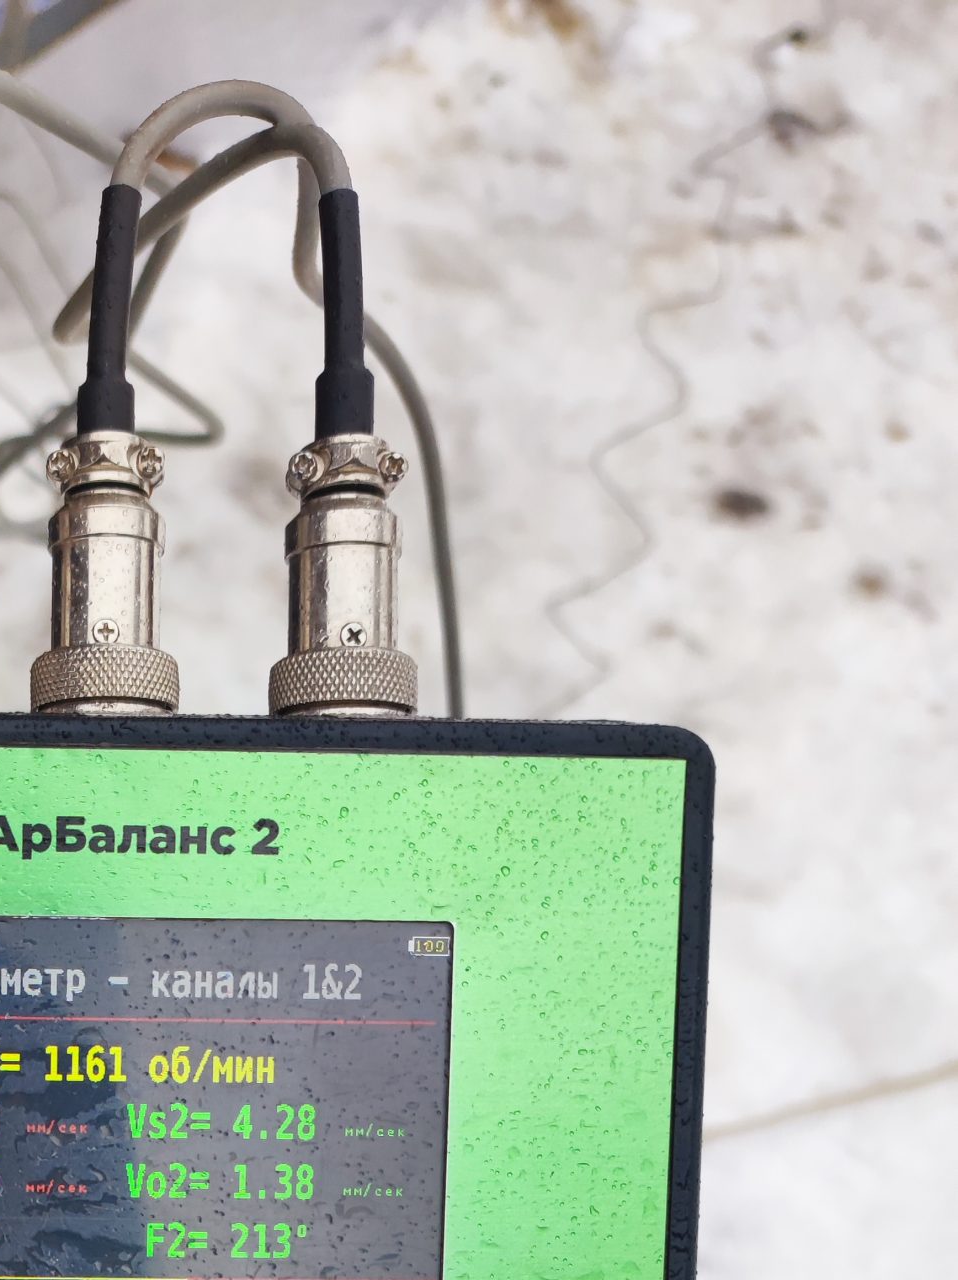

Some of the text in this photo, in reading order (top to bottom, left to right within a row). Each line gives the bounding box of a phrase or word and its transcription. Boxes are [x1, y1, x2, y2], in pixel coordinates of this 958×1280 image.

[251, 818, 280, 855] 2
[151, 970, 278, 999] каналы
[302, 963, 363, 1000] 1&2
[44, 1045, 127, 1083] 1161
[148, 1046, 276, 1084] об/мин
[26, 1119, 88, 1136] мм/сек
[126, 1102, 406, 1141] Vs2= 4.28 мм/сек
[25, 1179, 88, 1195] мм/сек
[125, 1162, 404, 1201] Vo2= 1.38 мм/сек
[146, 1221, 307, 1259] F2= 213°
